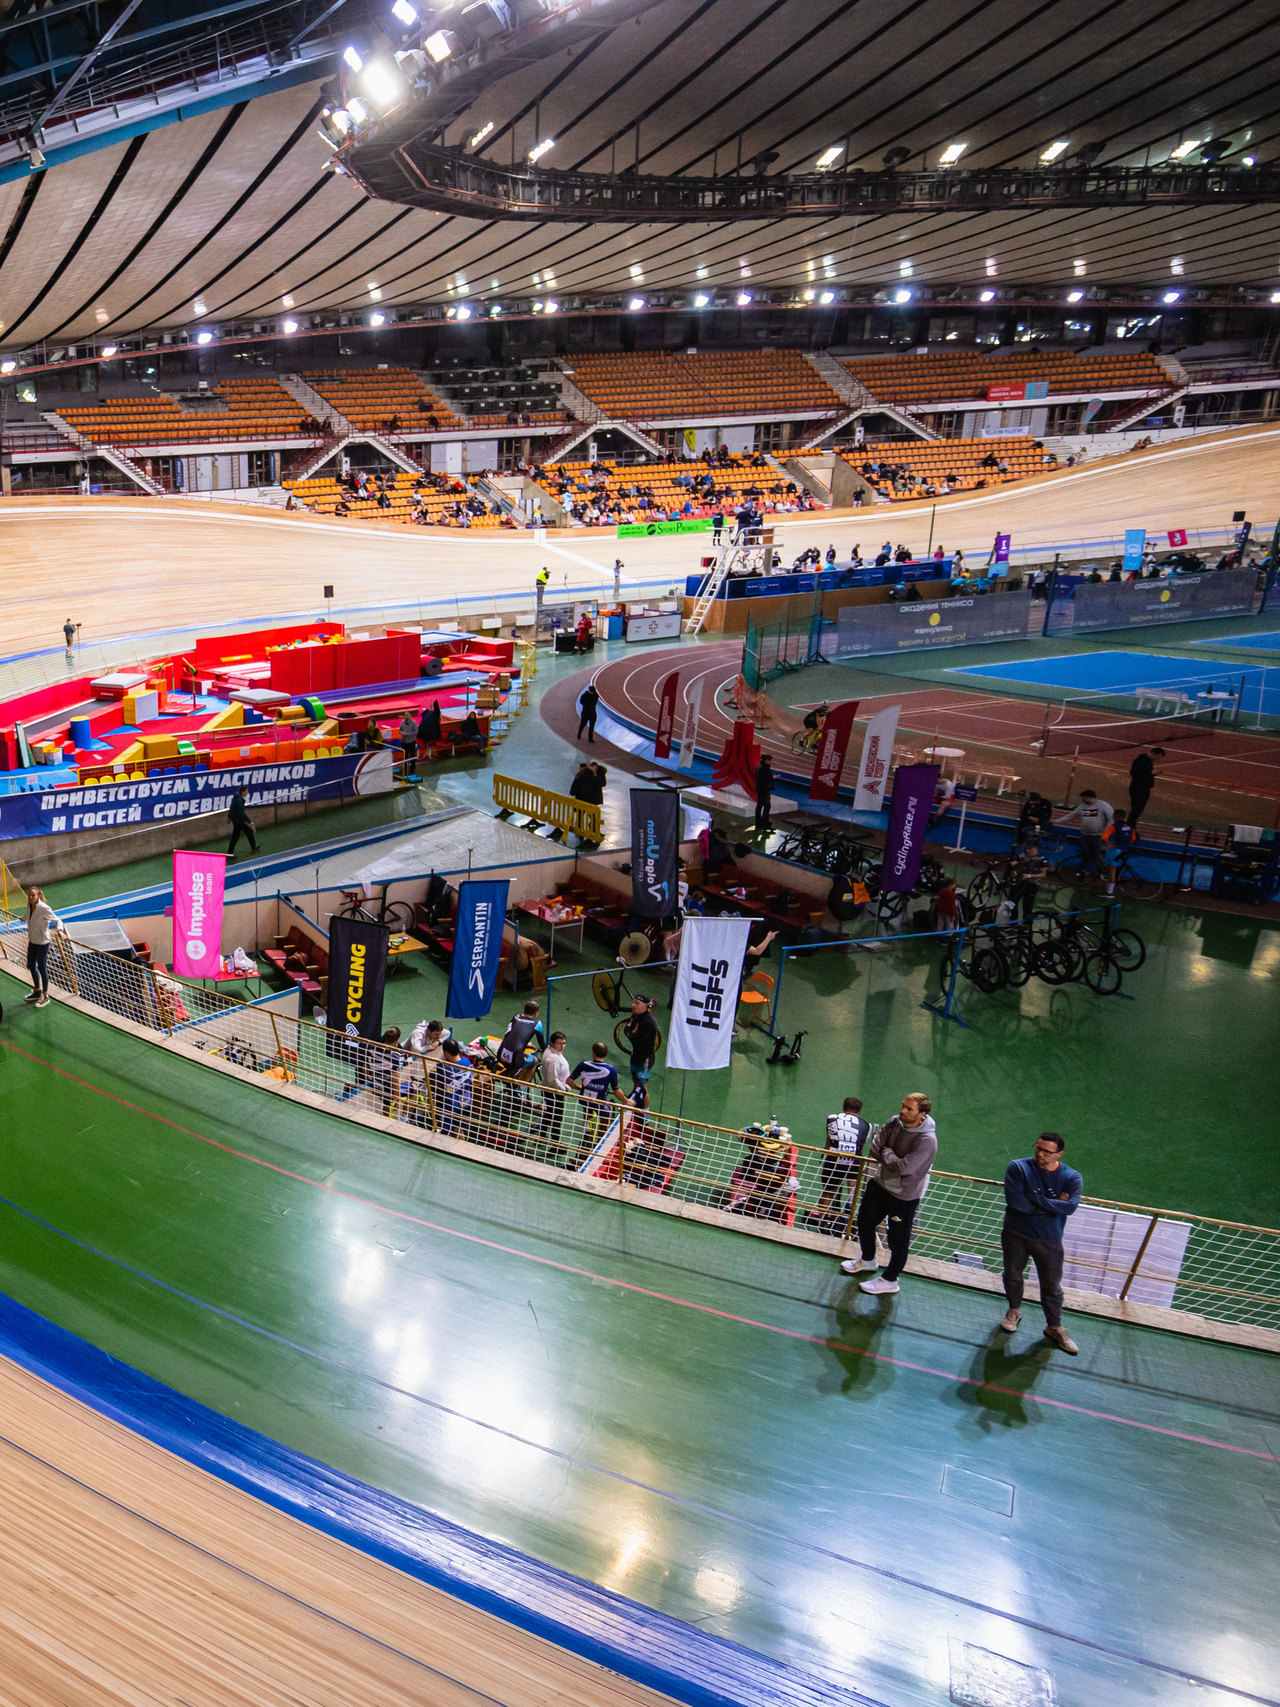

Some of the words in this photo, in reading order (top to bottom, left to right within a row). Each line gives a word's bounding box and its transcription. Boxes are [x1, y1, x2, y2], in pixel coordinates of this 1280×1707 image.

[40, 778, 191, 811] ПРИВЕТСТВУЕМ
[196, 763, 316, 791] УЧАСТНИКОВ
[51, 816, 67, 832] И
[72, 803, 142, 830] ГОСТЕЙ
[895, 797, 918, 876] CyclingRace.ru
[187, 872, 207, 936] Impulse
[205, 873, 213, 894] team
[471, 902, 488, 967] SERPANTIN
[346, 943, 367, 1023] CYCLING
